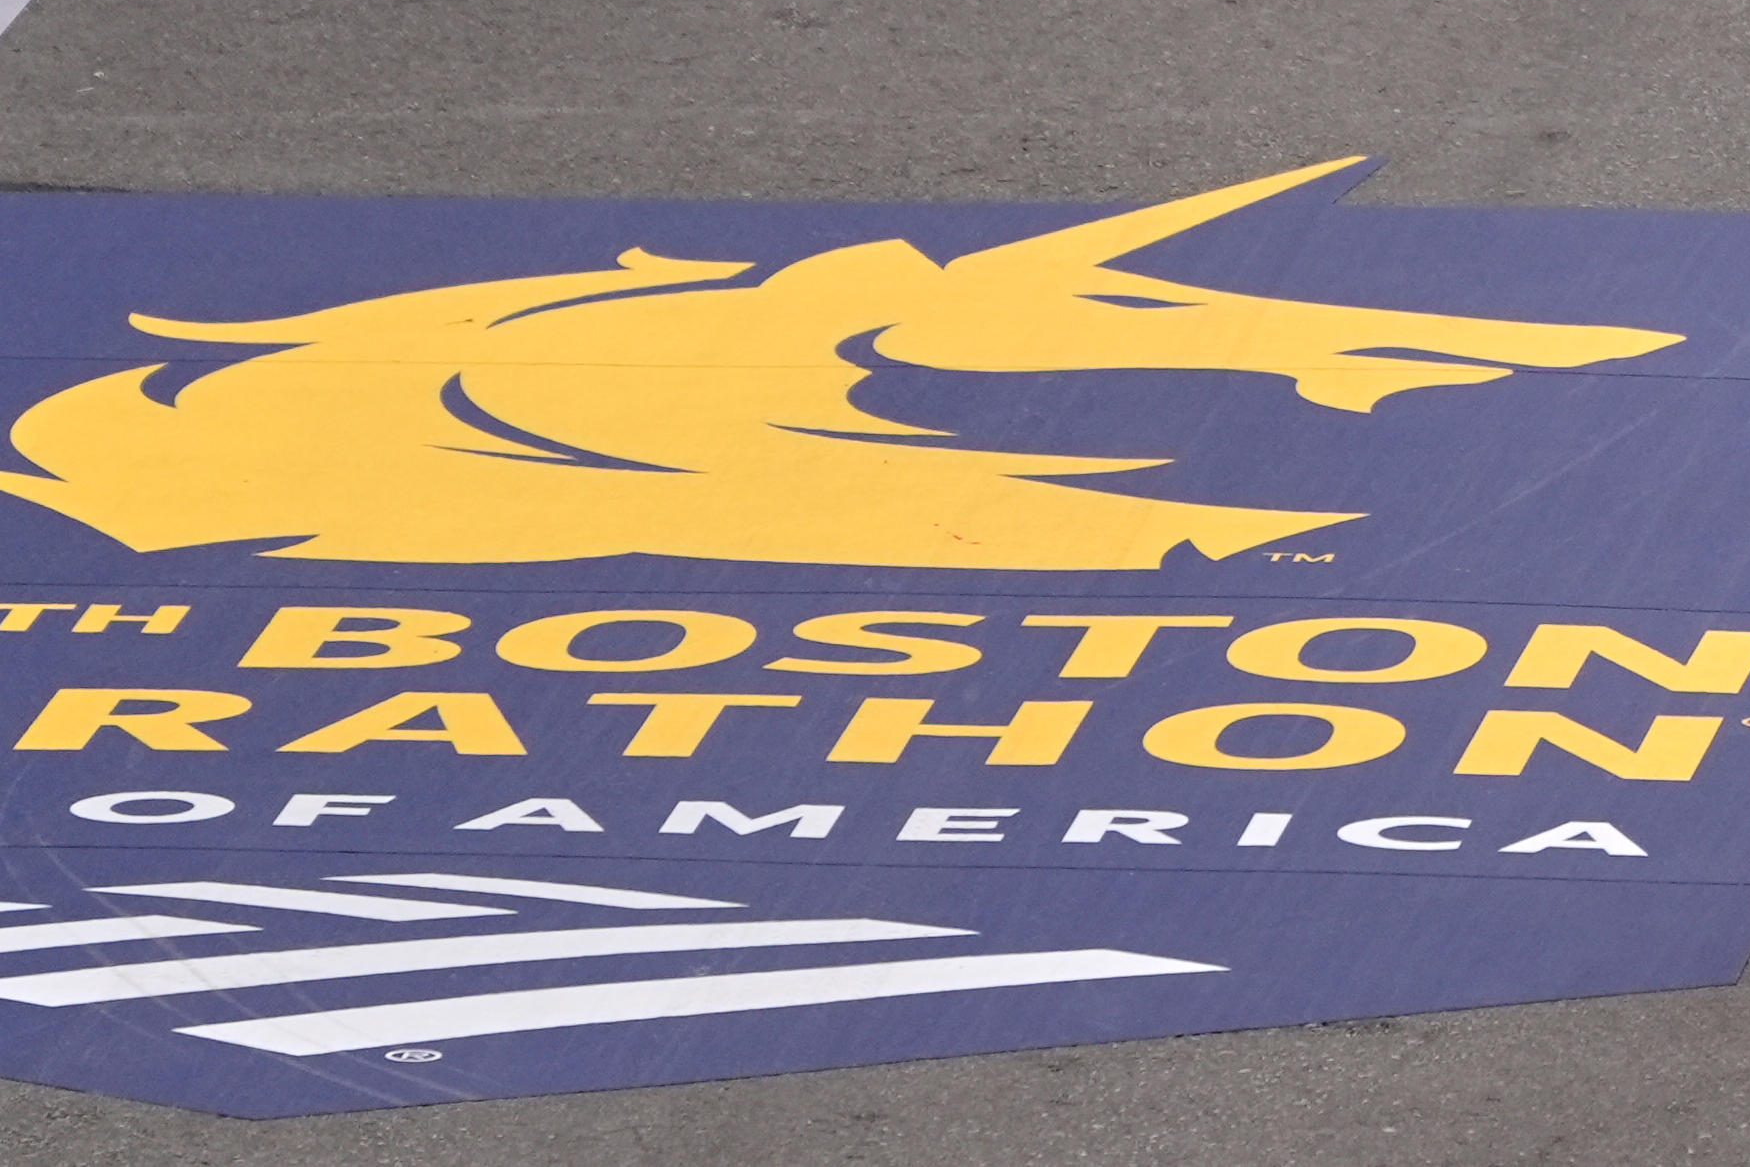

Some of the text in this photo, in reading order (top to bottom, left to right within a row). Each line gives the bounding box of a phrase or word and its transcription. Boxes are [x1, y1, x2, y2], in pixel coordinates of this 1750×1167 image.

[1262, 552, 1335, 563] TM
[69, 790, 1649, 857] OF AMERICA
